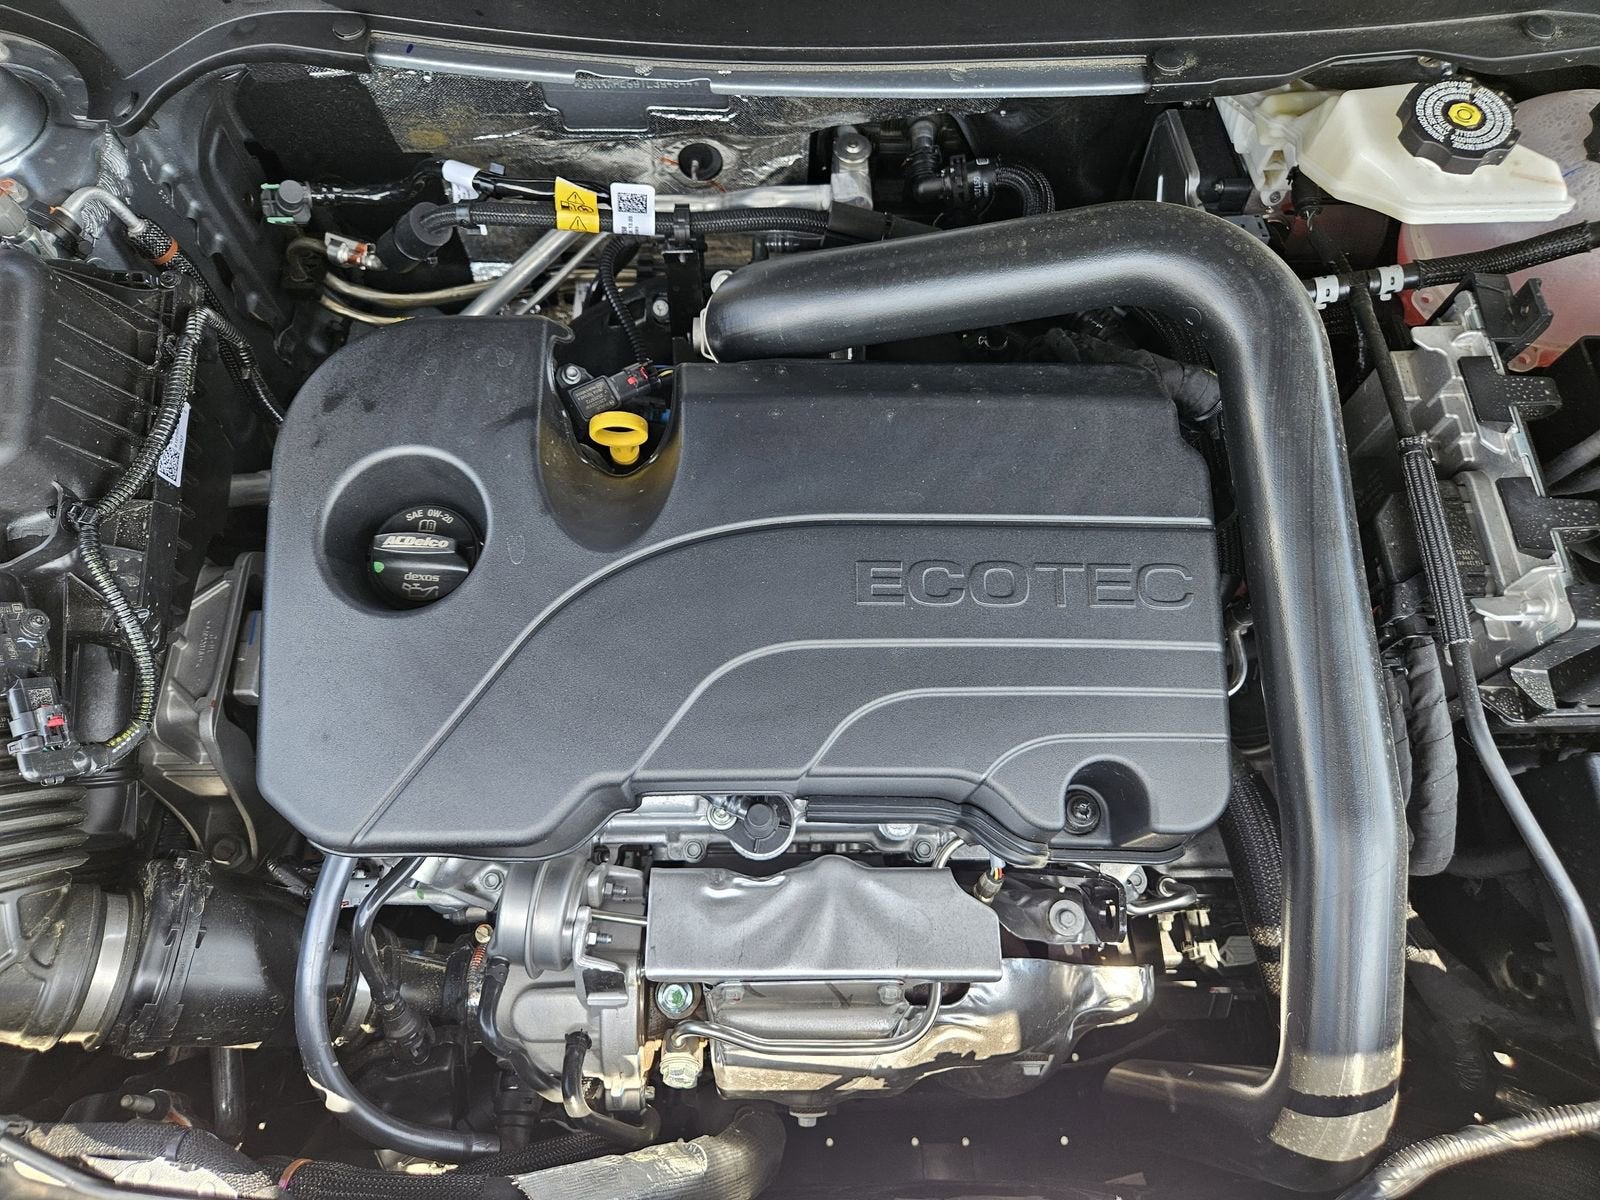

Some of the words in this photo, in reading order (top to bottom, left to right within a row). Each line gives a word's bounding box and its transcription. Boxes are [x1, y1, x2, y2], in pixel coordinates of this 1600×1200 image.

[406, 509, 424, 521] SAE
[427, 509, 454, 523] 0W-20
[382, 535, 449, 548] ACDelco
[403, 572, 440, 582] dexos
[854, 559, 1194, 611] ECOTEC
